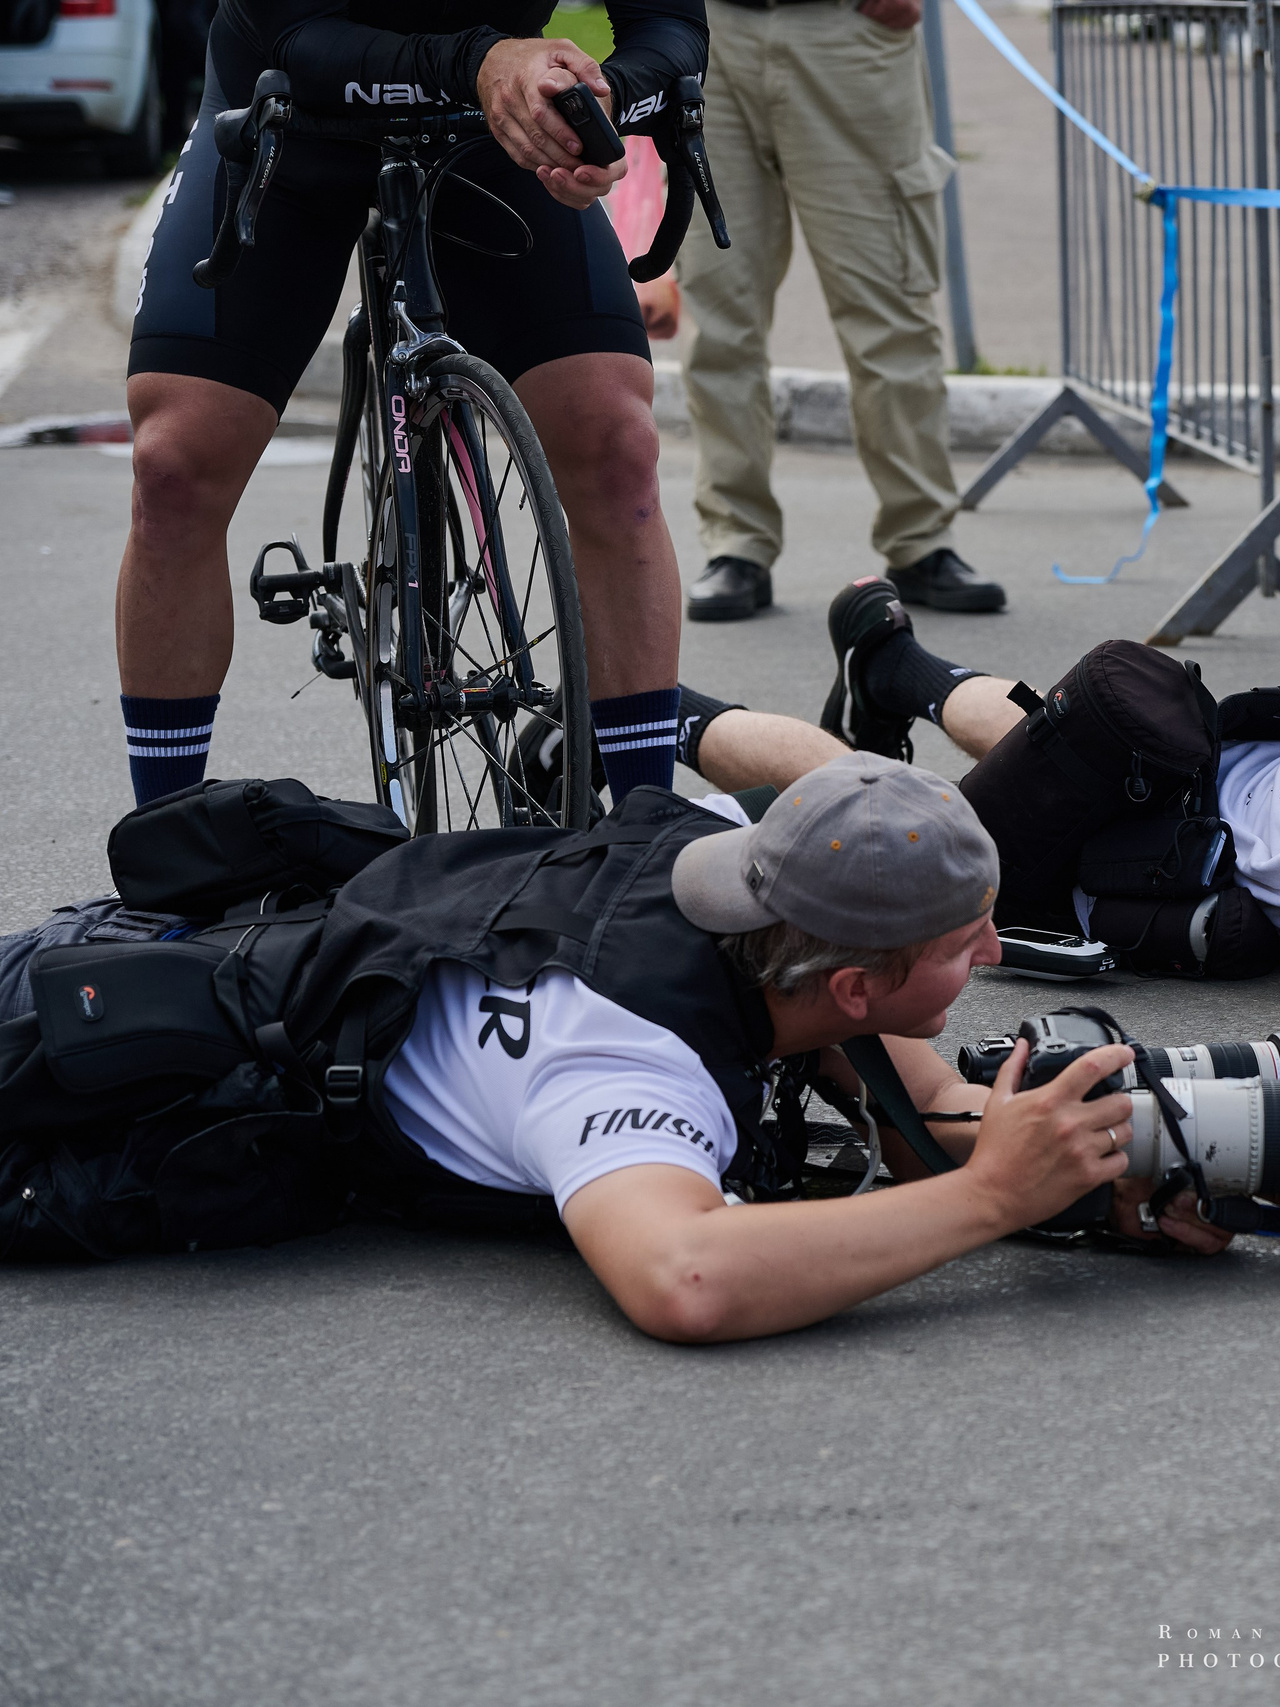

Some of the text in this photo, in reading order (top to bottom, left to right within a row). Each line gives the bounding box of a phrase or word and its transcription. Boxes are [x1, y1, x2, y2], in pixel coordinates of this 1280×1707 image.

[259, 146, 276, 190] ULTEGRA
[694, 151, 711, 193] ULTEGRA
[391, 394, 412, 474] ONDA
